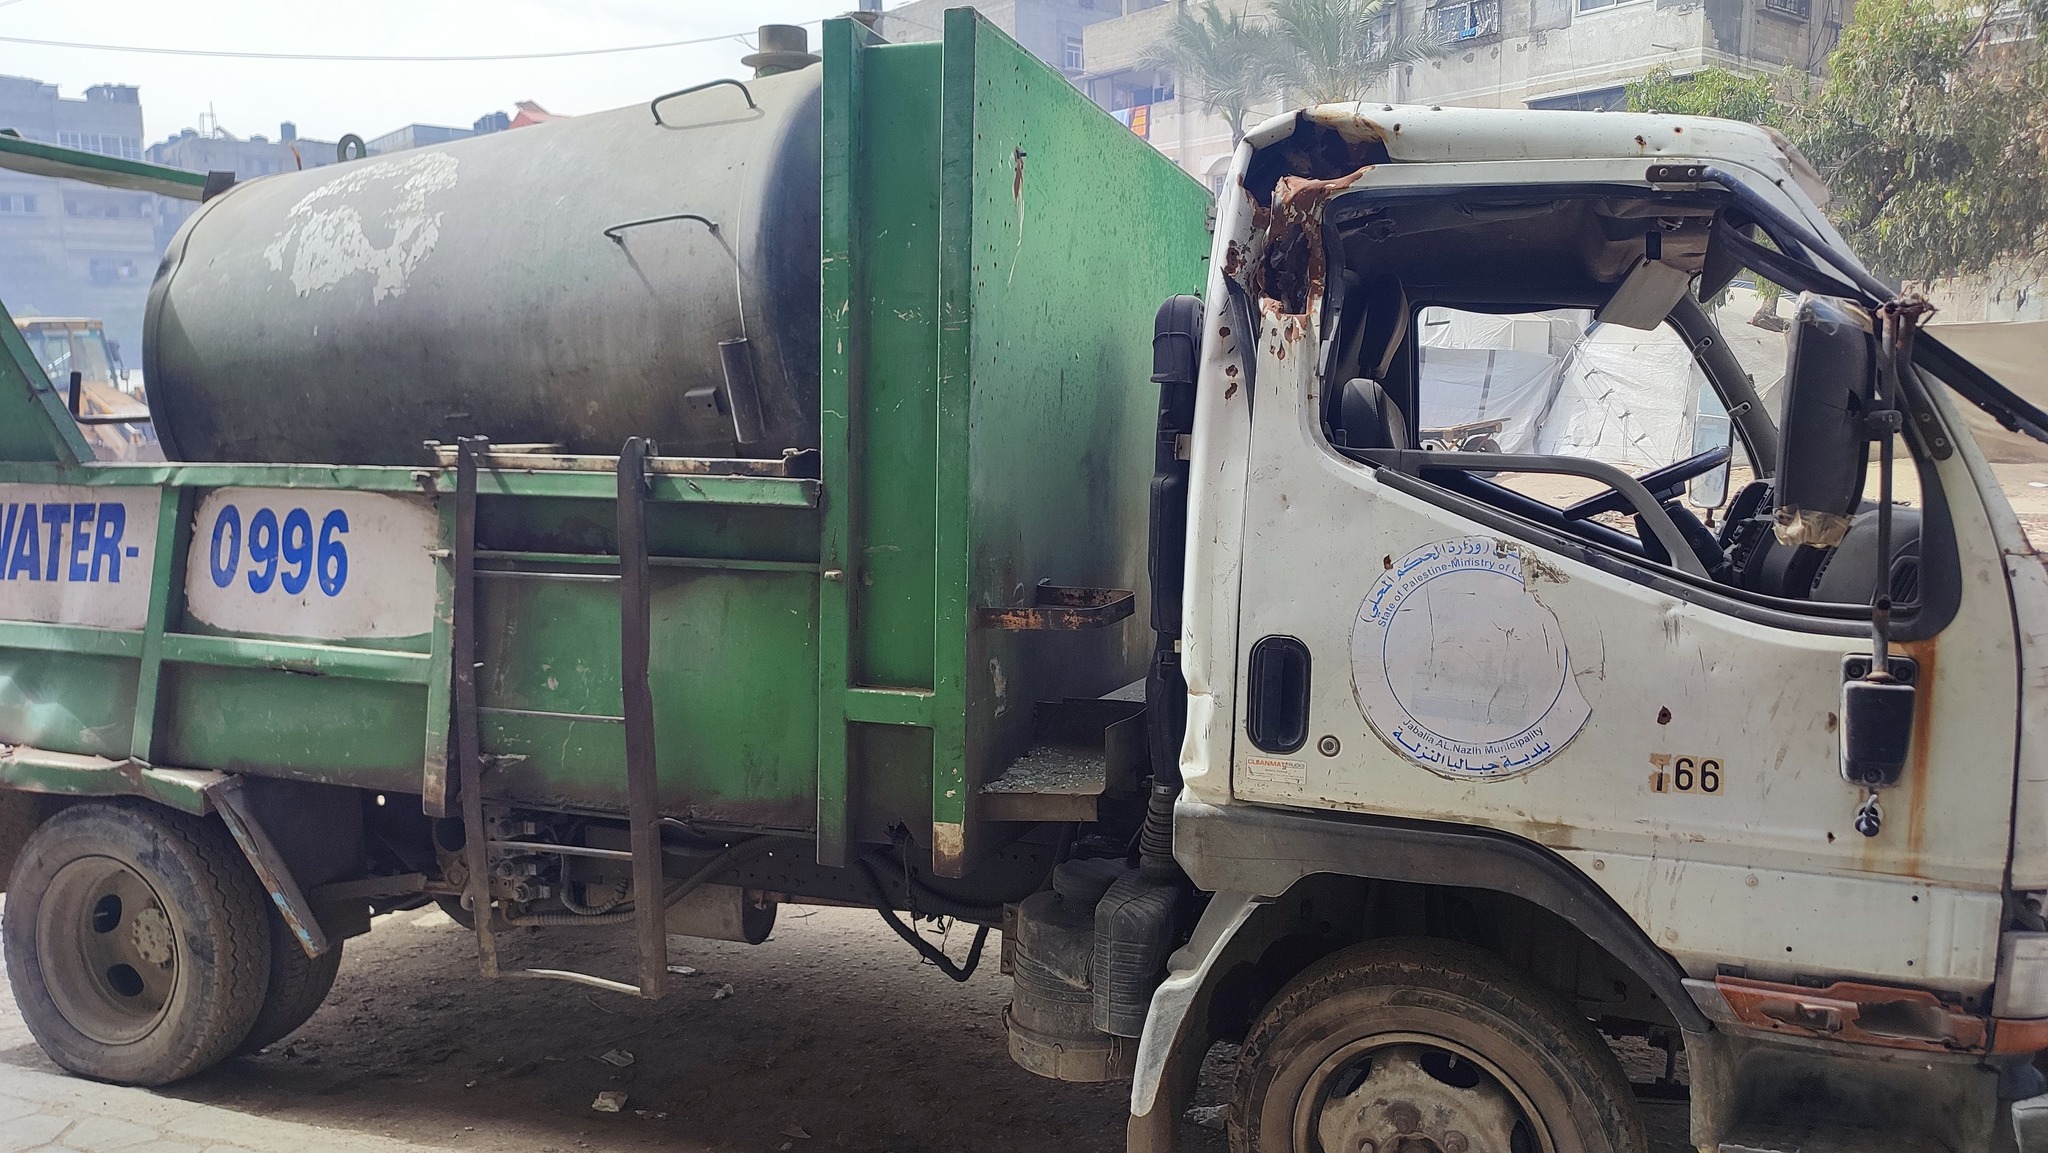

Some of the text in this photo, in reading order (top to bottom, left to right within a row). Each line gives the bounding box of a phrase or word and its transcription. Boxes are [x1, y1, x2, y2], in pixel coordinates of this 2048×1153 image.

[210, 504, 349, 597] 0996
[1396, 543, 1447, 582] الحكم
[1378, 603, 1396, 628] State
[1394, 592, 1404, 603] of
[1499, 563, 1511, 572] of
[1392, 725, 1551, 775] بلدية جباليا النزلة
[1403, 719, 1435, 744] Jabalia
[1485, 726, 1544, 755] Municipality
